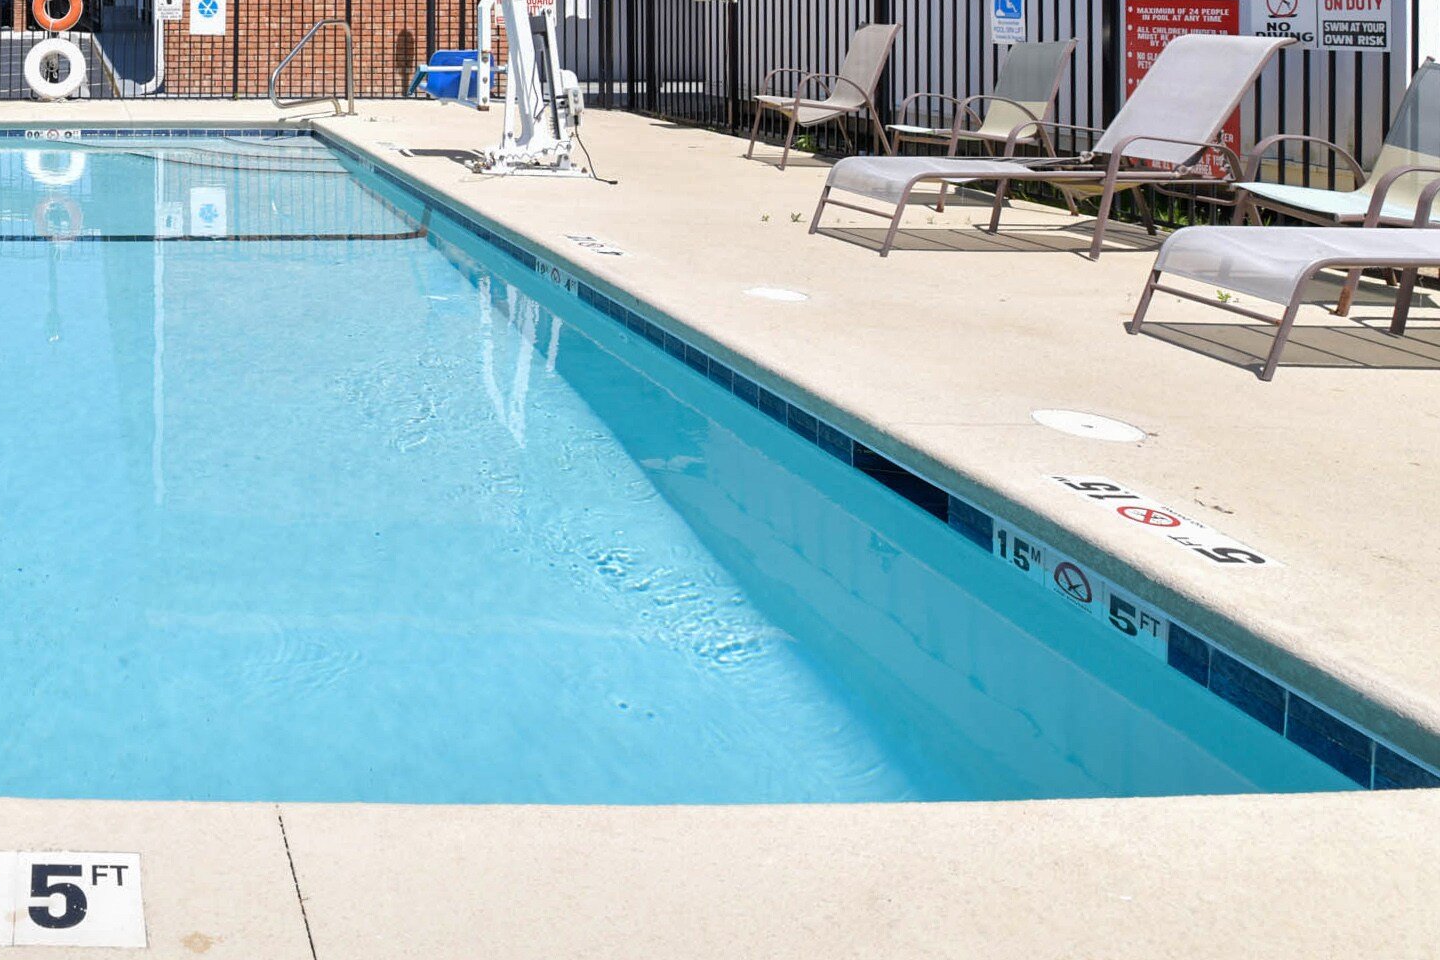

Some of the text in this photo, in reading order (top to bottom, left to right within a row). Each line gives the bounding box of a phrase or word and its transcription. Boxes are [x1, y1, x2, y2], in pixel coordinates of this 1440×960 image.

[1137, 7, 1175, 15] MAXIMUM
[1201, 8, 1229, 16] PEOPLE
[1203, 15, 1222, 23] TIME
[1266, 22, 1291, 31] NO
[1324, 22, 1385, 33] SWIM AT YOUR
[1324, 35, 1385, 45] OWN RISK
